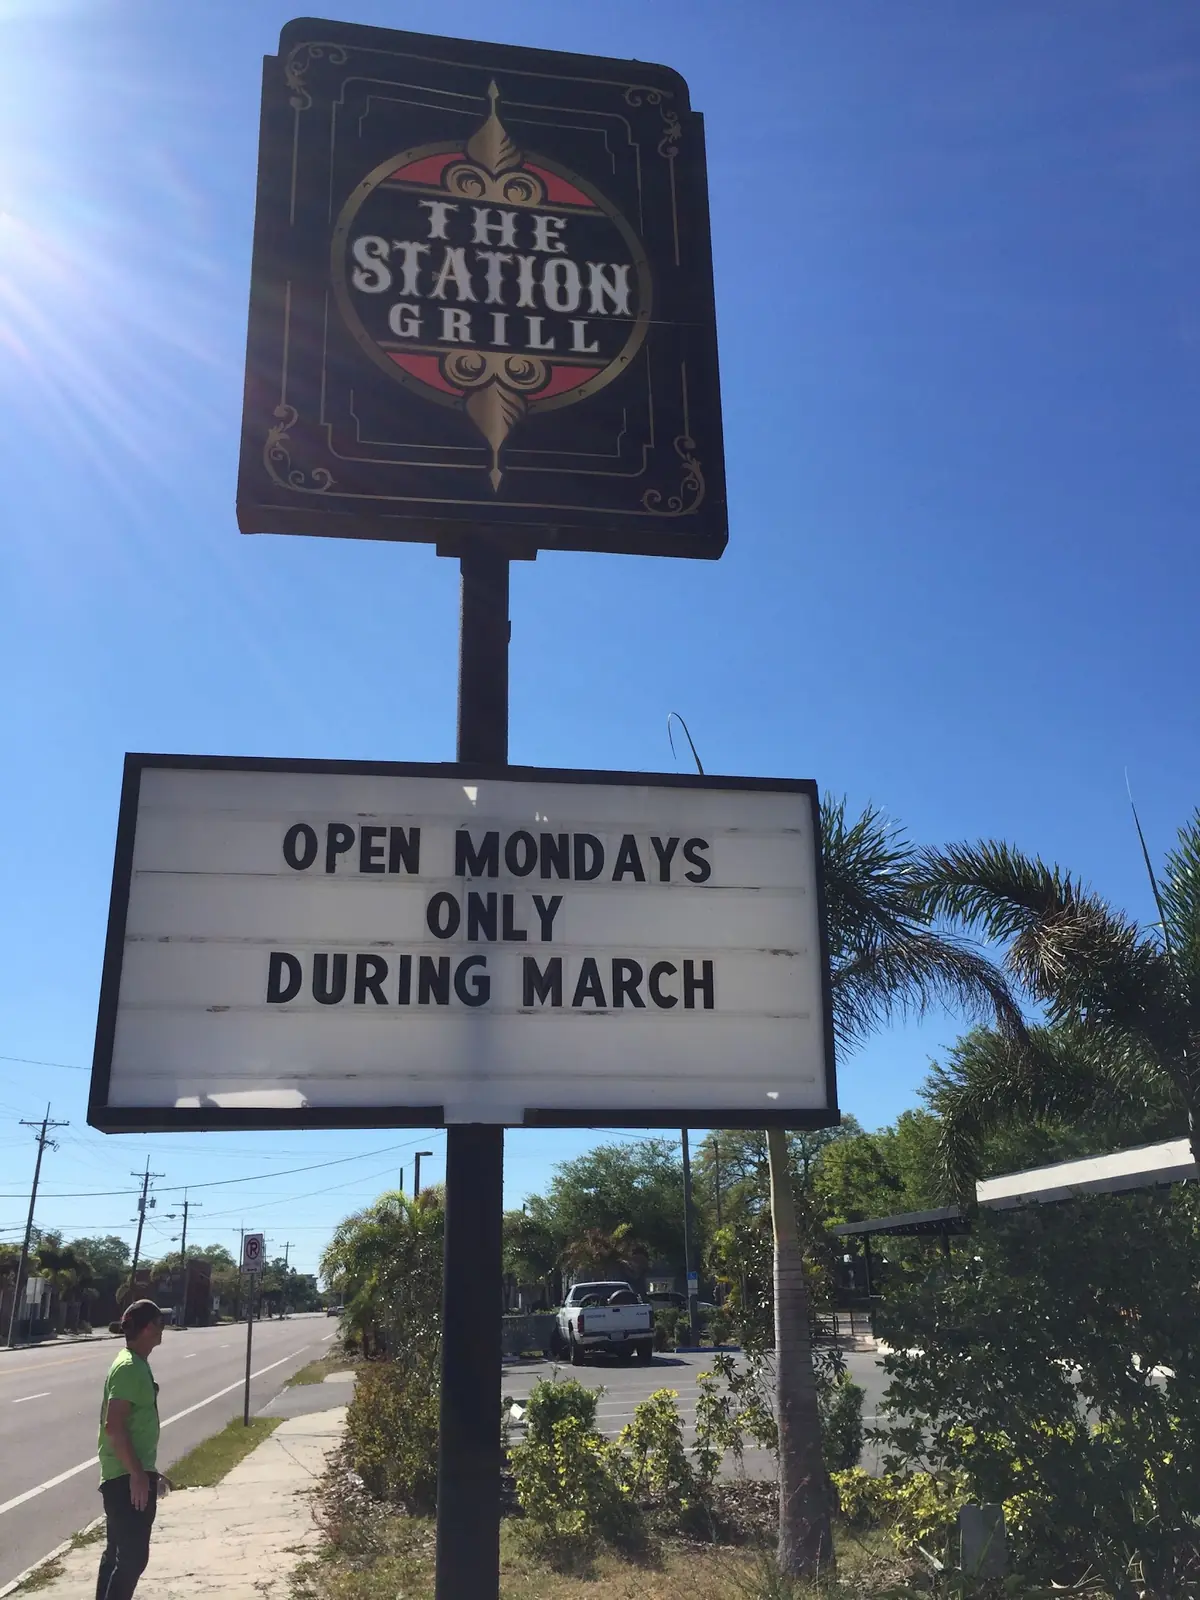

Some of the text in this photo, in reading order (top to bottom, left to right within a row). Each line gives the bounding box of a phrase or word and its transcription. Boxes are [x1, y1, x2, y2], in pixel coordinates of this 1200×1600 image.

[419, 200, 567, 253] THE
[352, 236, 631, 315] STATION
[389, 303, 599, 353] GRILL
[283, 823, 711, 883] OPEN MONDAYS
[426, 892, 563, 942] ONLY
[267, 952, 716, 1009] DURING MARCH
